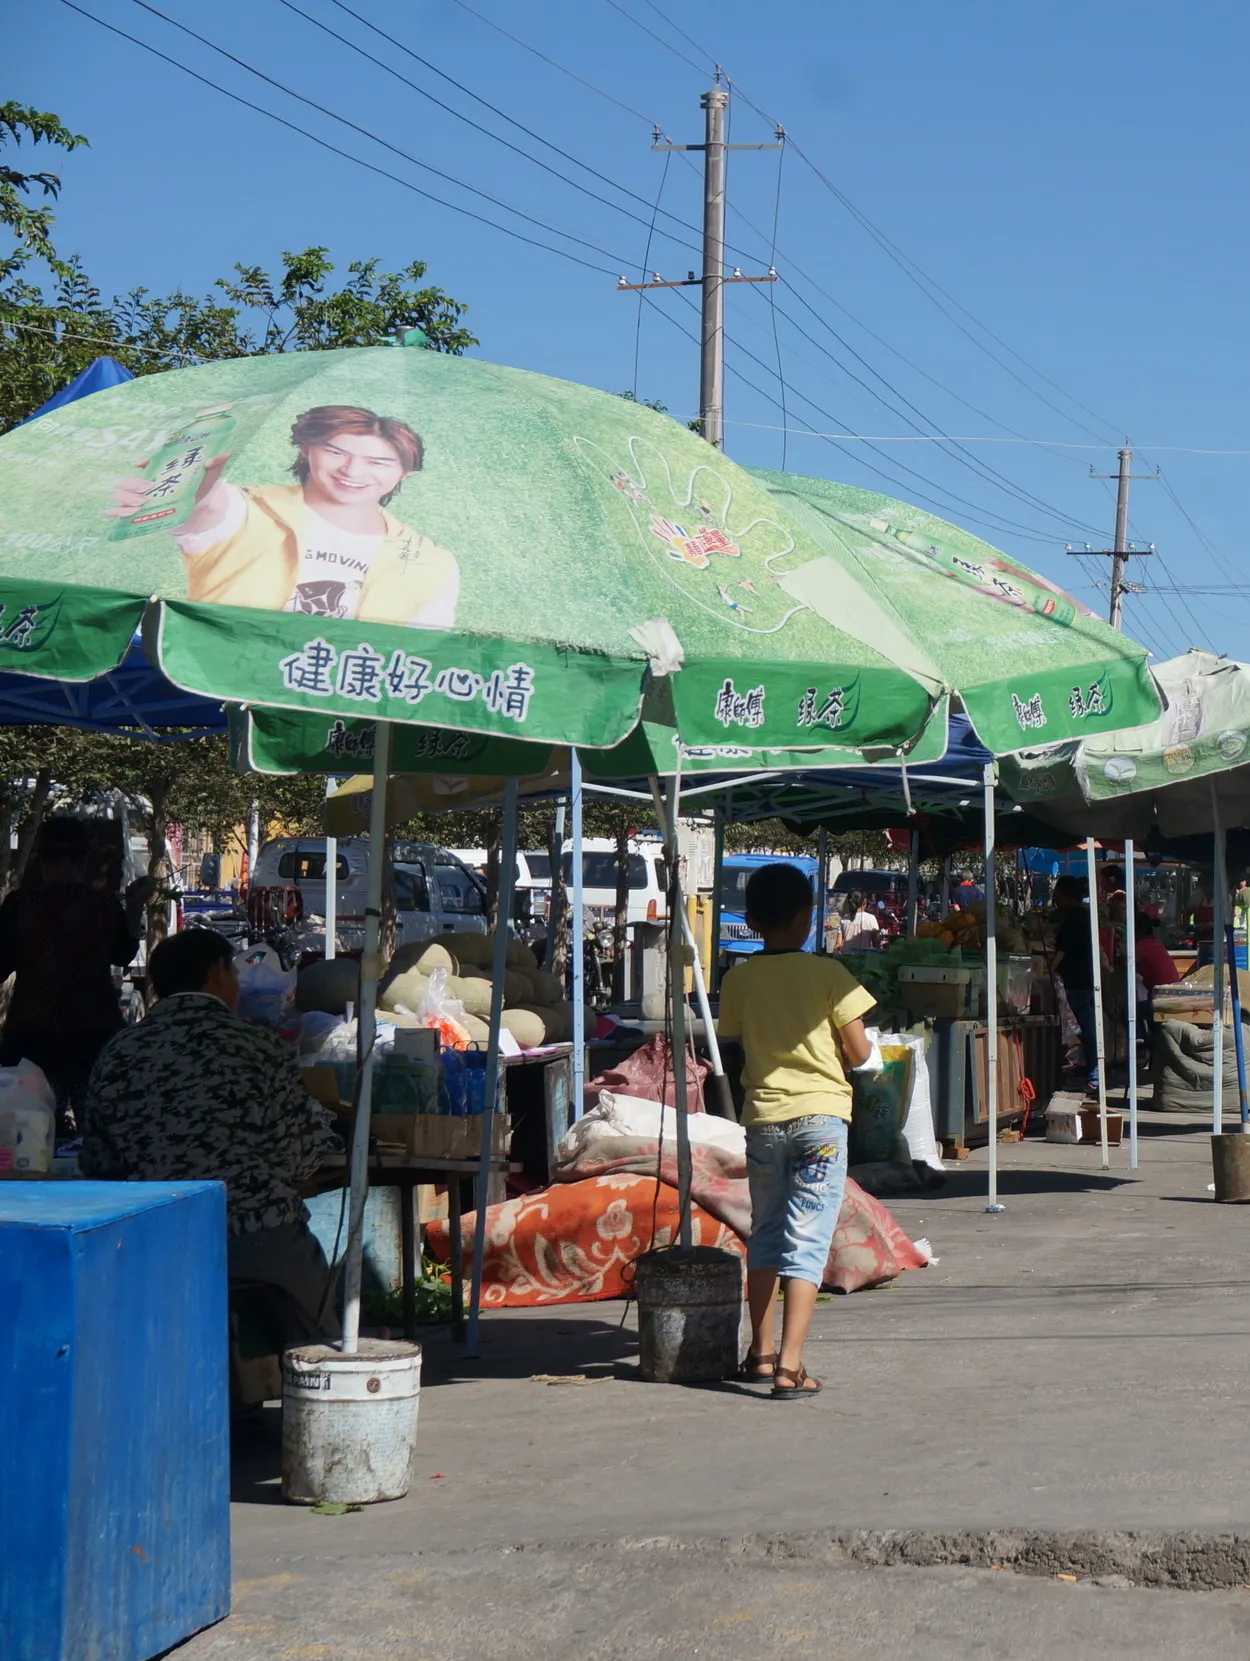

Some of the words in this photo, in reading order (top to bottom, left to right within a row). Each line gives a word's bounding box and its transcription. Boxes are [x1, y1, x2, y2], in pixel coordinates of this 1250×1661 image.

[0, 604, 38, 648] 茶
[280, 637, 534, 721] 健康好心情
[1068, 682, 1105, 718] 绿茶
[796, 687, 844, 729] 绿茶
